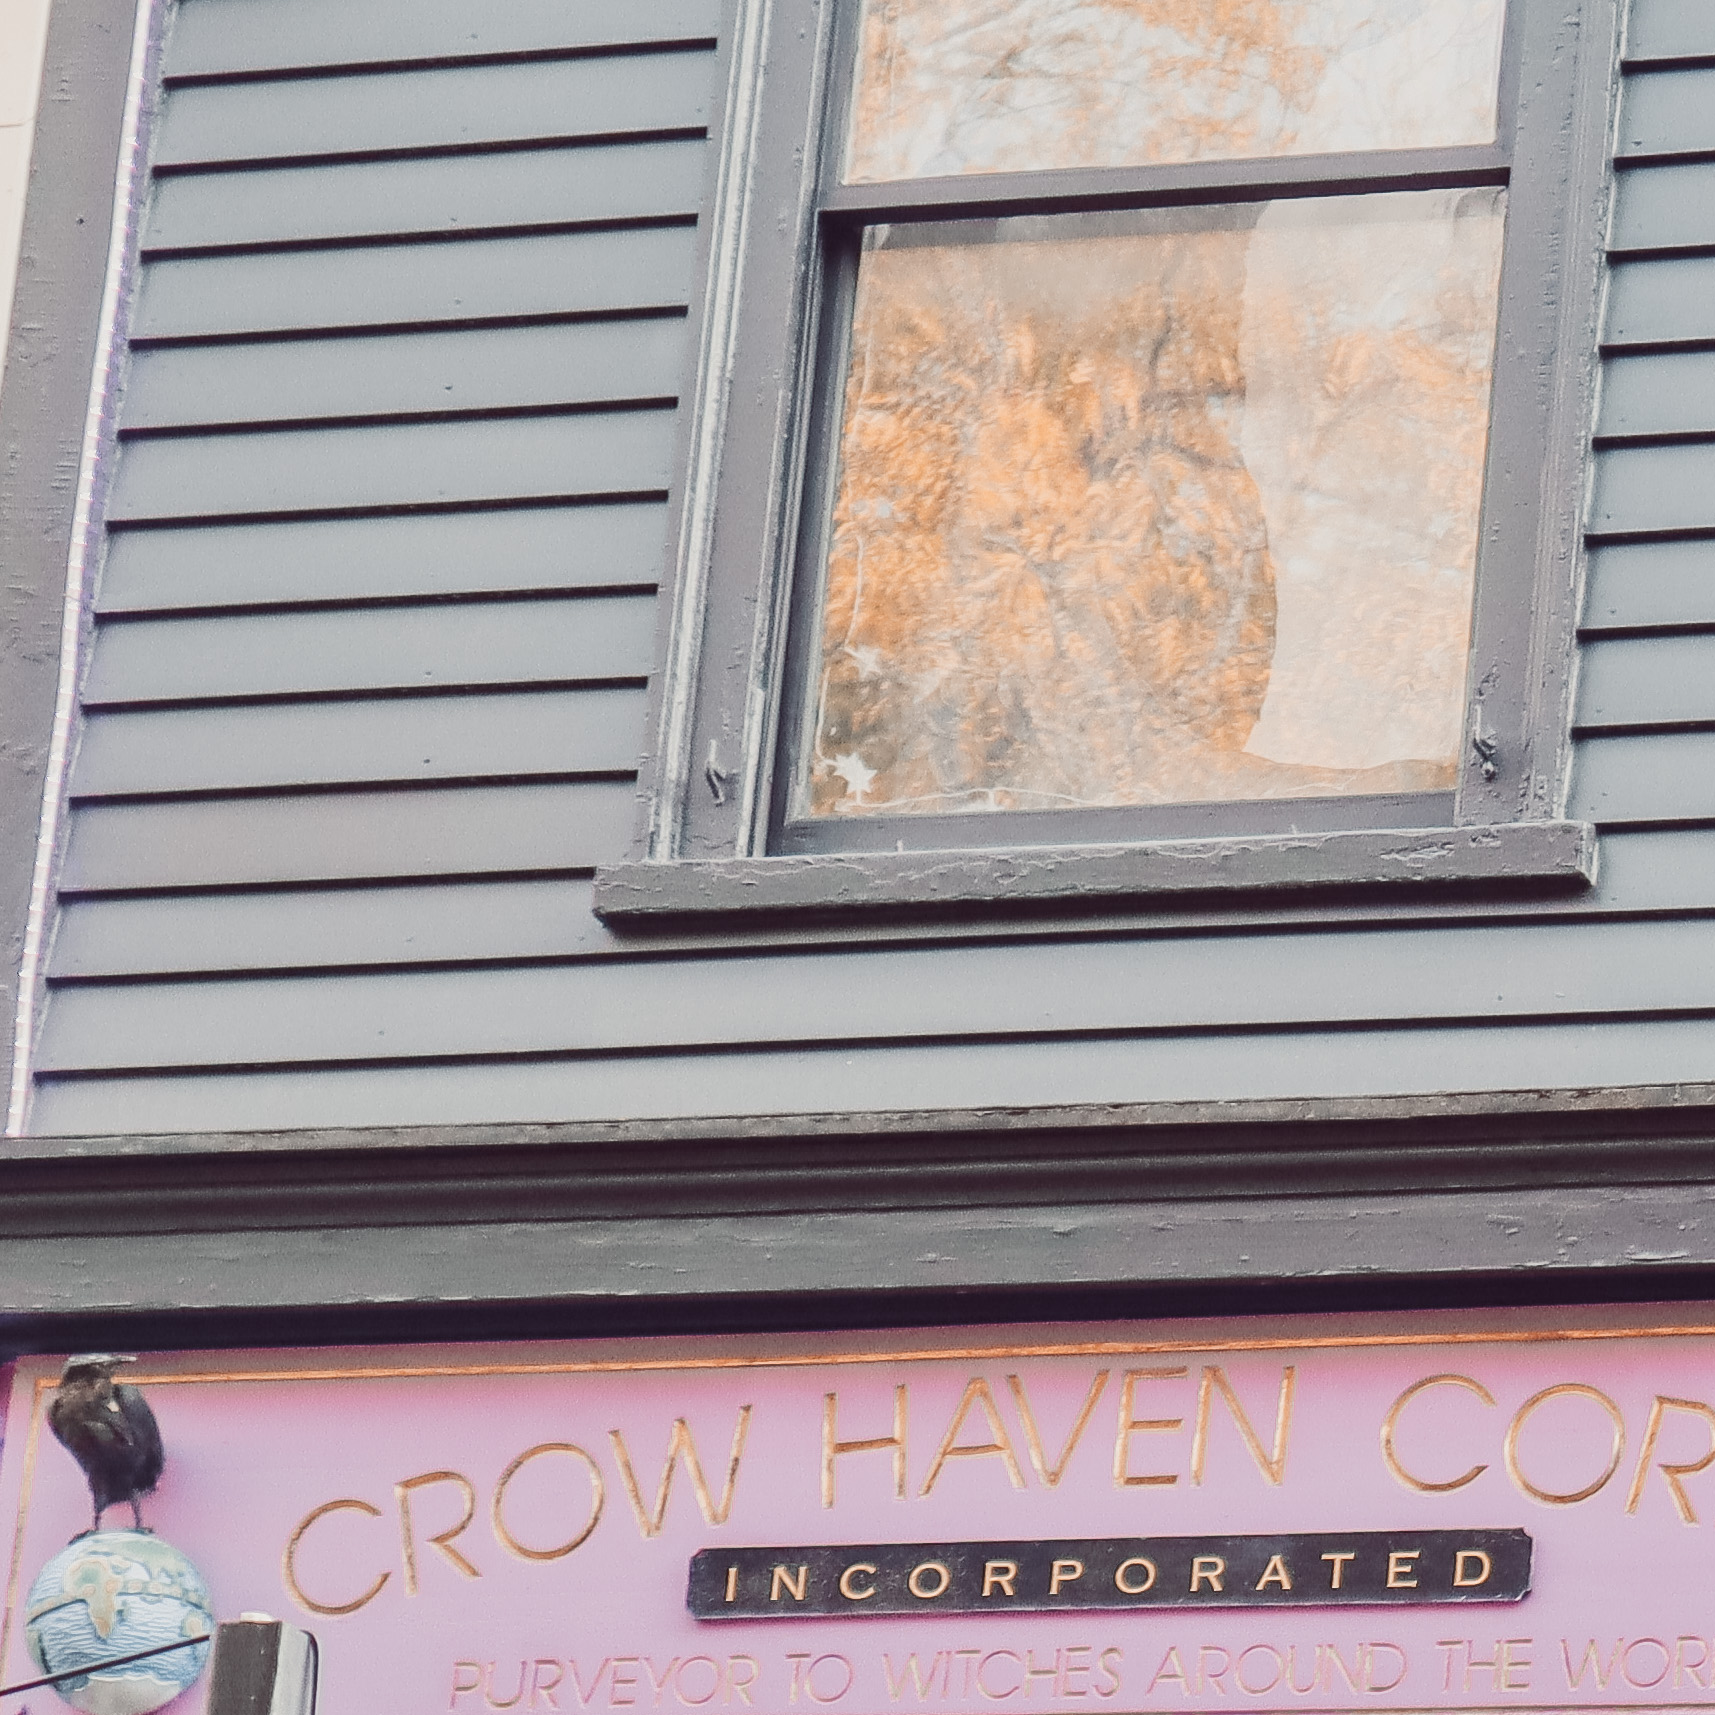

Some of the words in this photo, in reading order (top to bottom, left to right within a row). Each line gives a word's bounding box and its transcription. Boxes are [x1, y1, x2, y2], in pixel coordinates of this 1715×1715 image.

[281, 1405, 753, 1617] CROW
[821, 1365, 1297, 1509] HAVEN
[724, 1548, 1494, 1604] INCORPORATED
[448, 1654, 761, 1711] PURVEYOR
[783, 1651, 856, 1704] TO
[881, 1645, 1124, 1704] WITCHES
[1145, 1641, 1408, 1698] AROUND
[1434, 1637, 1536, 1695] THE
